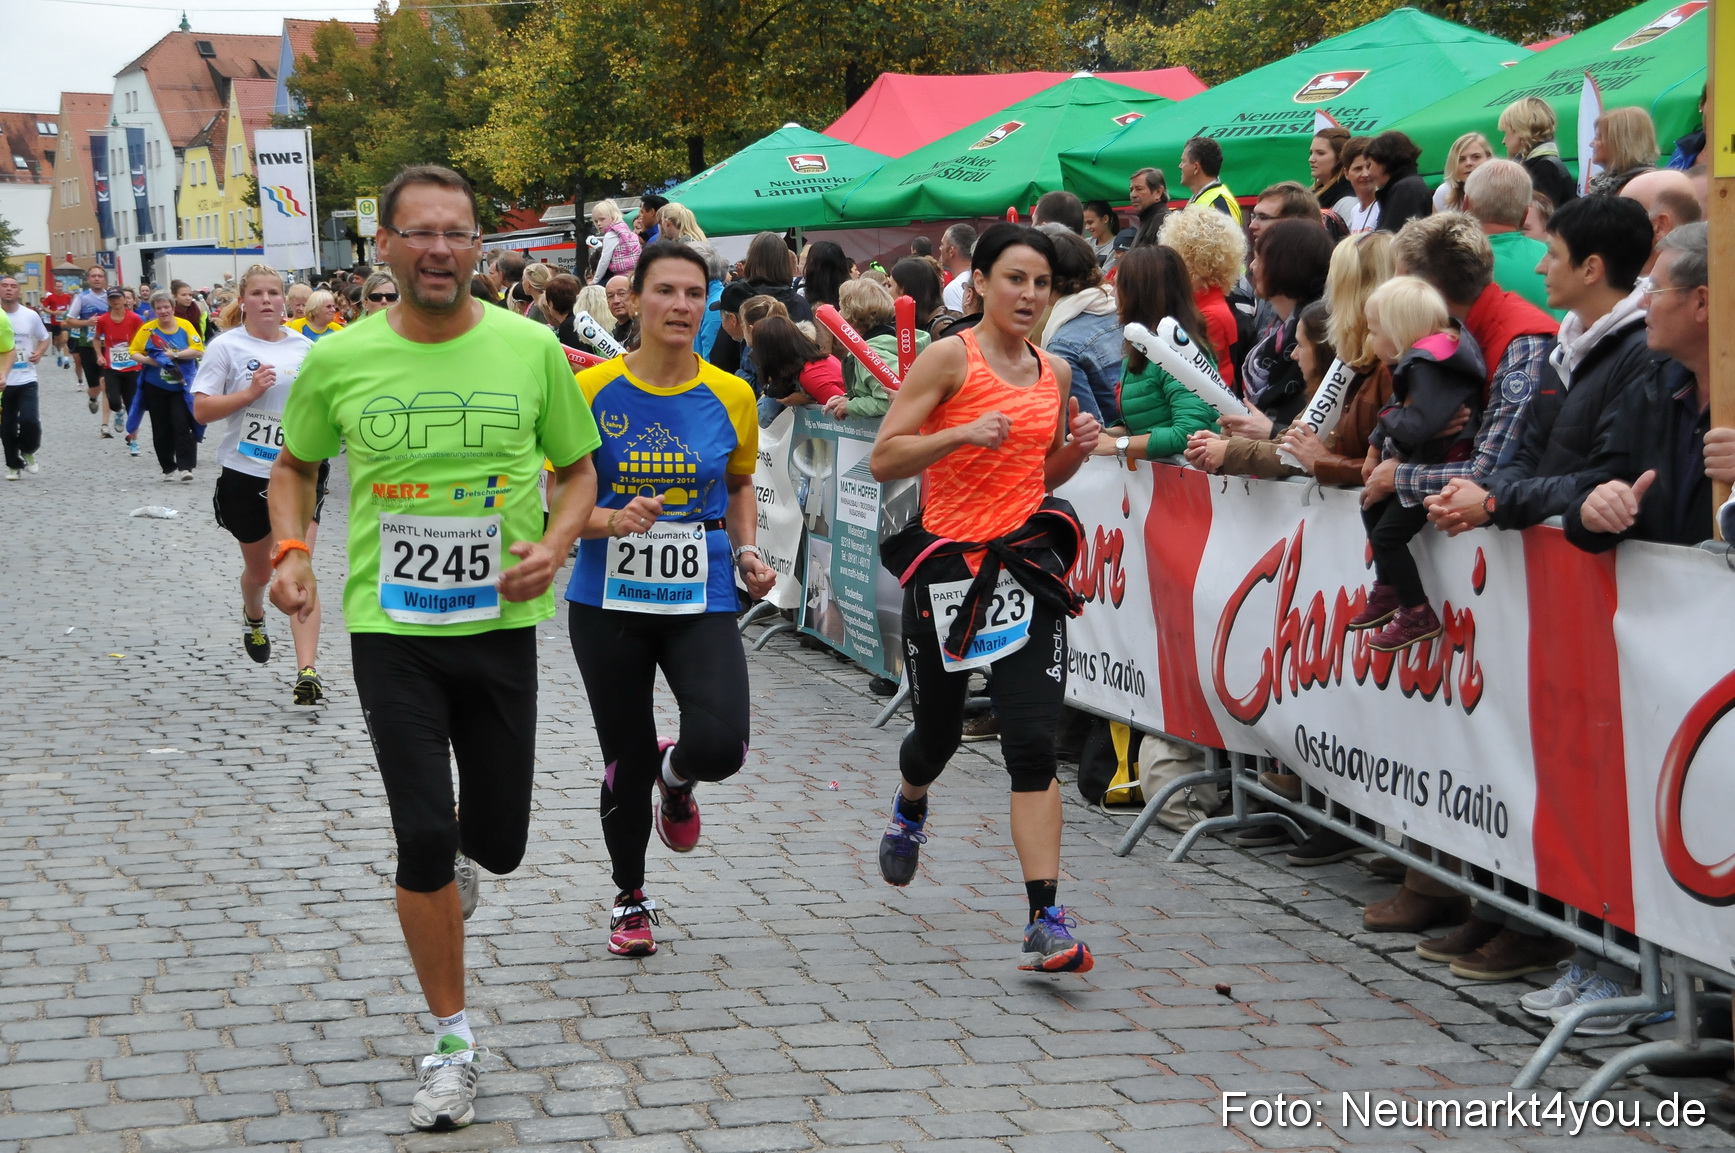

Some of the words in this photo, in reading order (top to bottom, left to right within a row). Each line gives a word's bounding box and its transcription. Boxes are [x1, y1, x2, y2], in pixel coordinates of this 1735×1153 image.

[1193, 117, 1379, 139] Lammsbäu
[112, 352, 132, 362] 262
[245, 412, 267, 421] PARTL
[395, 453, 408, 461] und
[409, 449, 494, 459] Automatisierungstechnik
[454, 486, 513, 500] Bretschneider
[857, 484, 878, 500] HOFFER
[382, 522, 421, 537] PARTL
[424, 528, 483, 539] Neumarkt
[645, 531, 691, 541] Neumarkt
[393, 540, 491, 583] 2245
[618, 542, 699, 579] 2108
[618, 583, 693, 601] Anna-Maria
[933, 590, 966, 601] PARTL
[995, 578, 1014, 589] arkt
[404, 590, 476, 612] Wolfgang
[945, 588, 1026, 627] 223
[973, 635, 1008, 654] Maria
[1101, 651, 1146, 698] Radio
[1294, 723, 1430, 807] Ostbayerns
[1437, 768, 1509, 839] Radio
